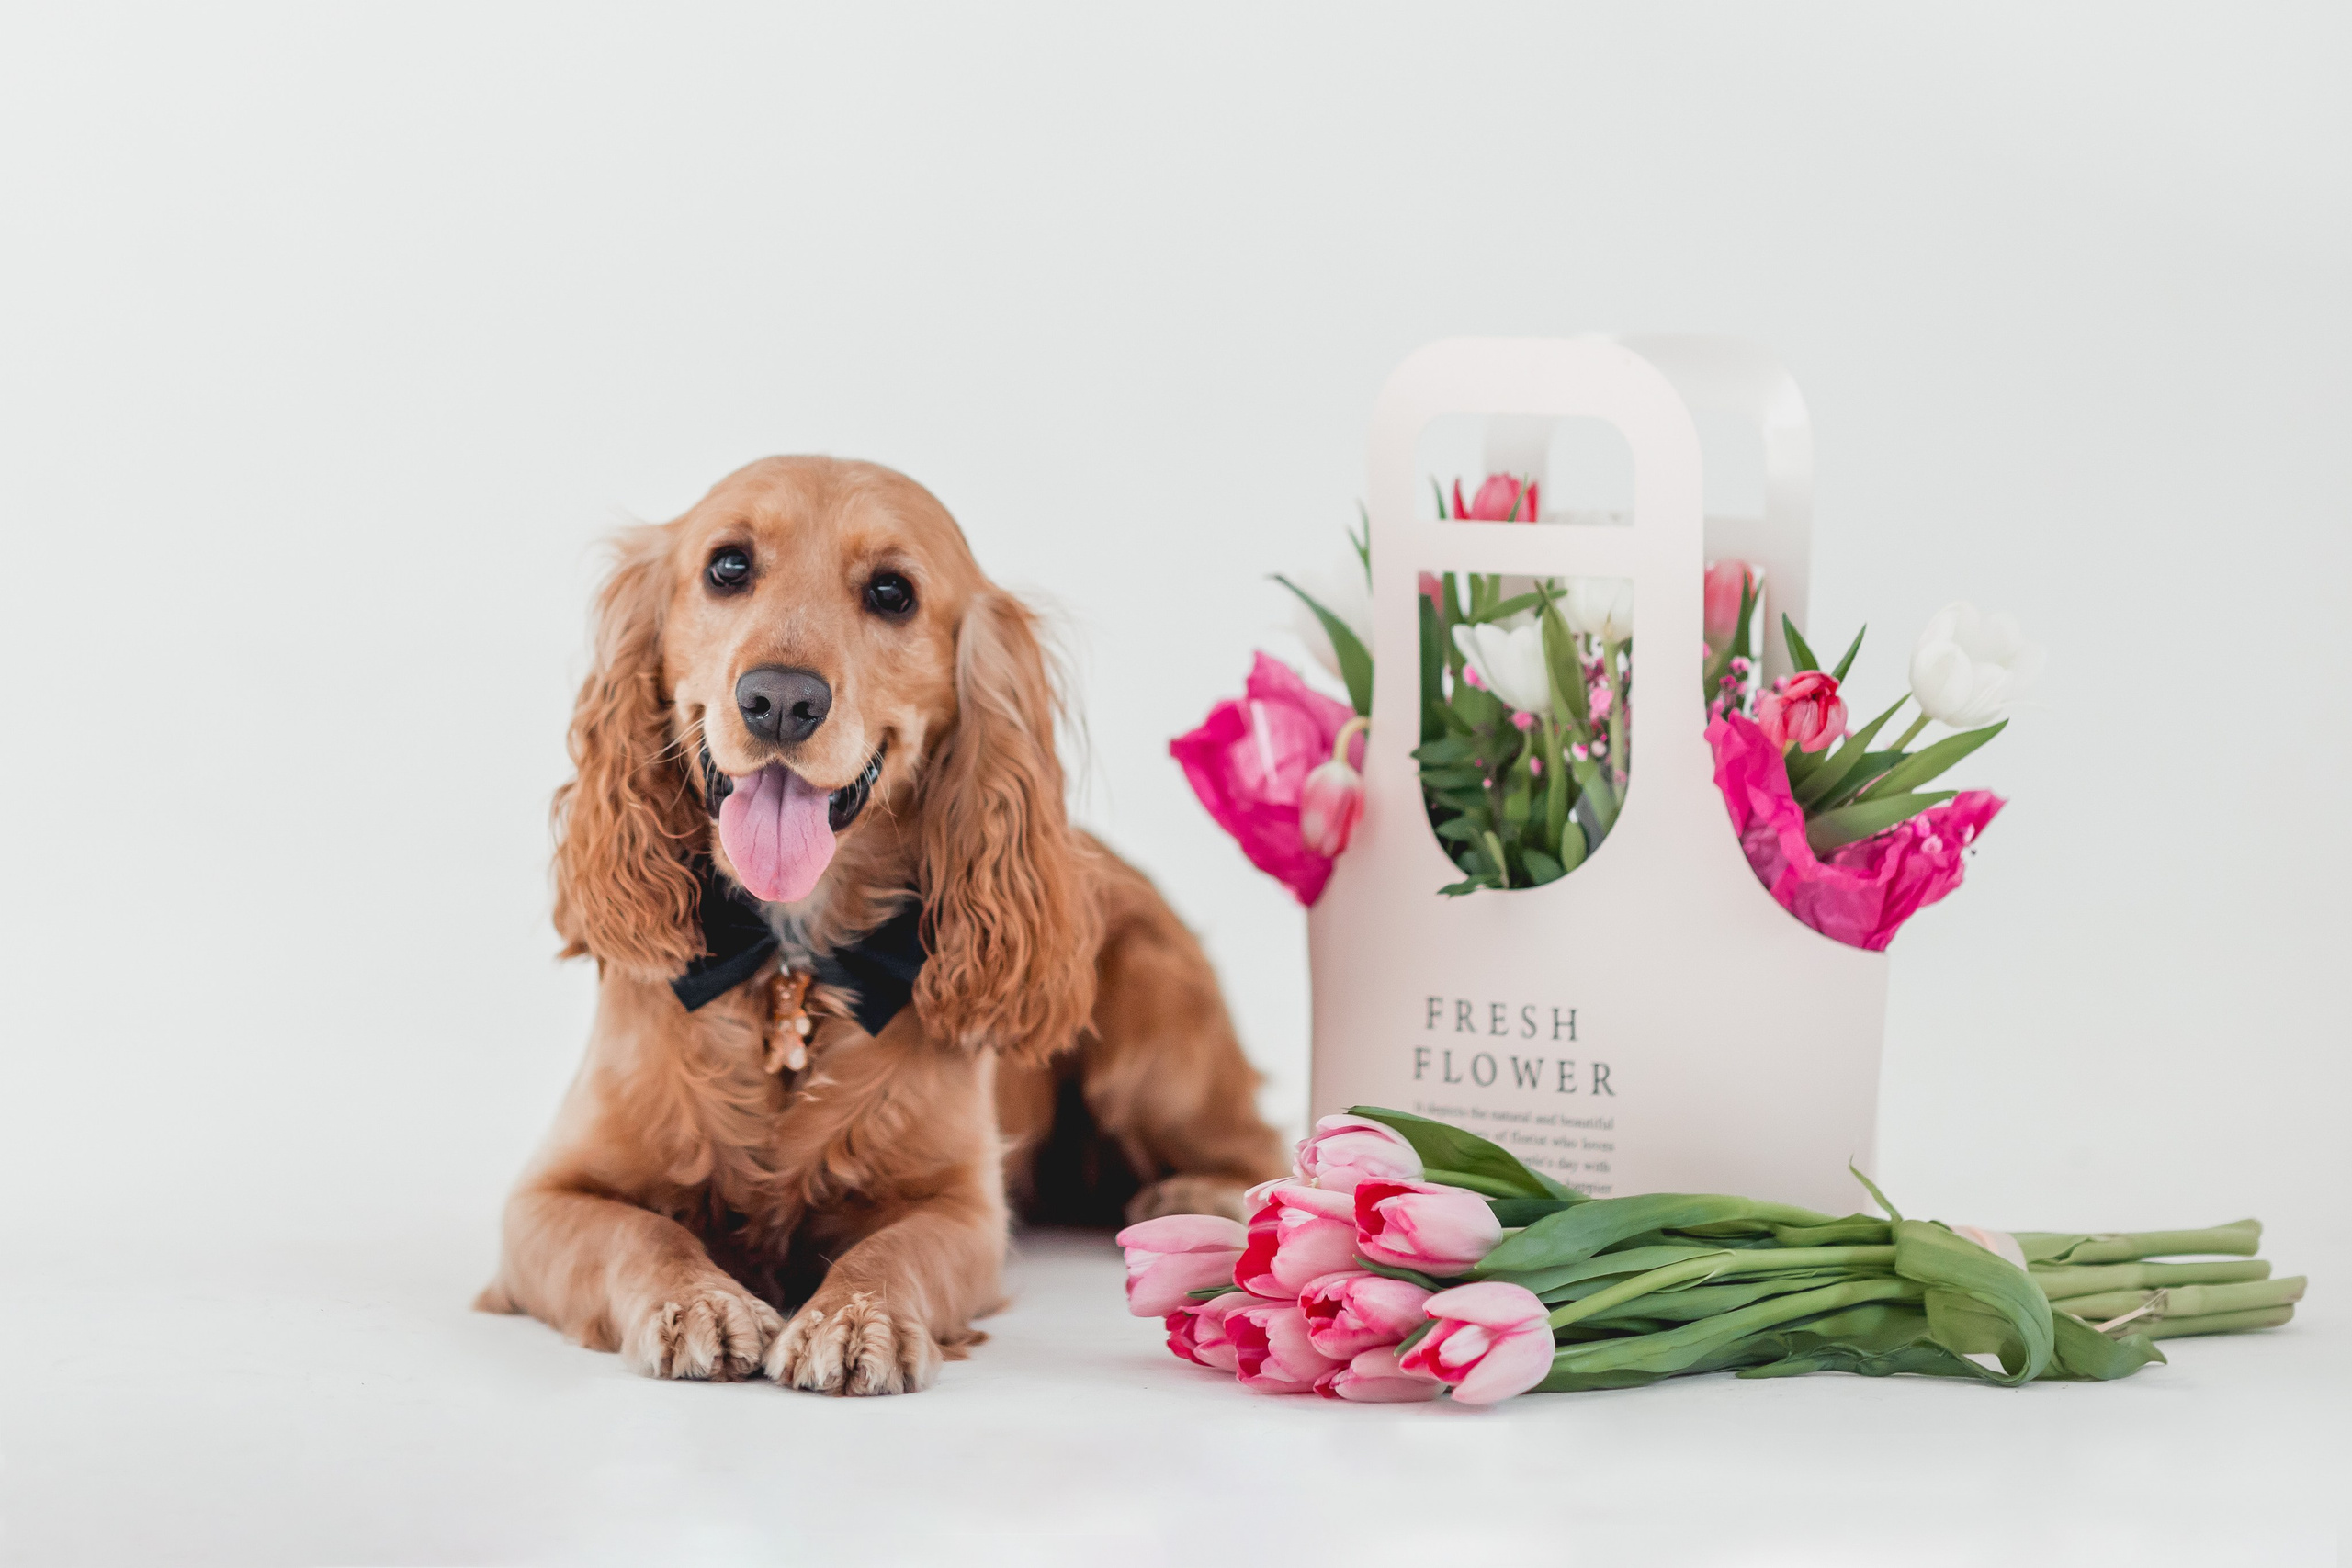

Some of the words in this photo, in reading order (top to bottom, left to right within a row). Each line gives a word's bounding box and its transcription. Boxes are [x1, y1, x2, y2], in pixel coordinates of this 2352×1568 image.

[1426, 995, 1577, 1042] FRESH
[1413, 1046, 1615, 1096] FLOWER
[1471, 1107, 1486, 1119] the
[1535, 1113, 1556, 1126] and
[1560, 1113, 1614, 1131] beautiful
[1553, 1135, 1577, 1148] who
[1558, 1157, 1578, 1174] day
[1585, 1161, 1611, 1173] with
